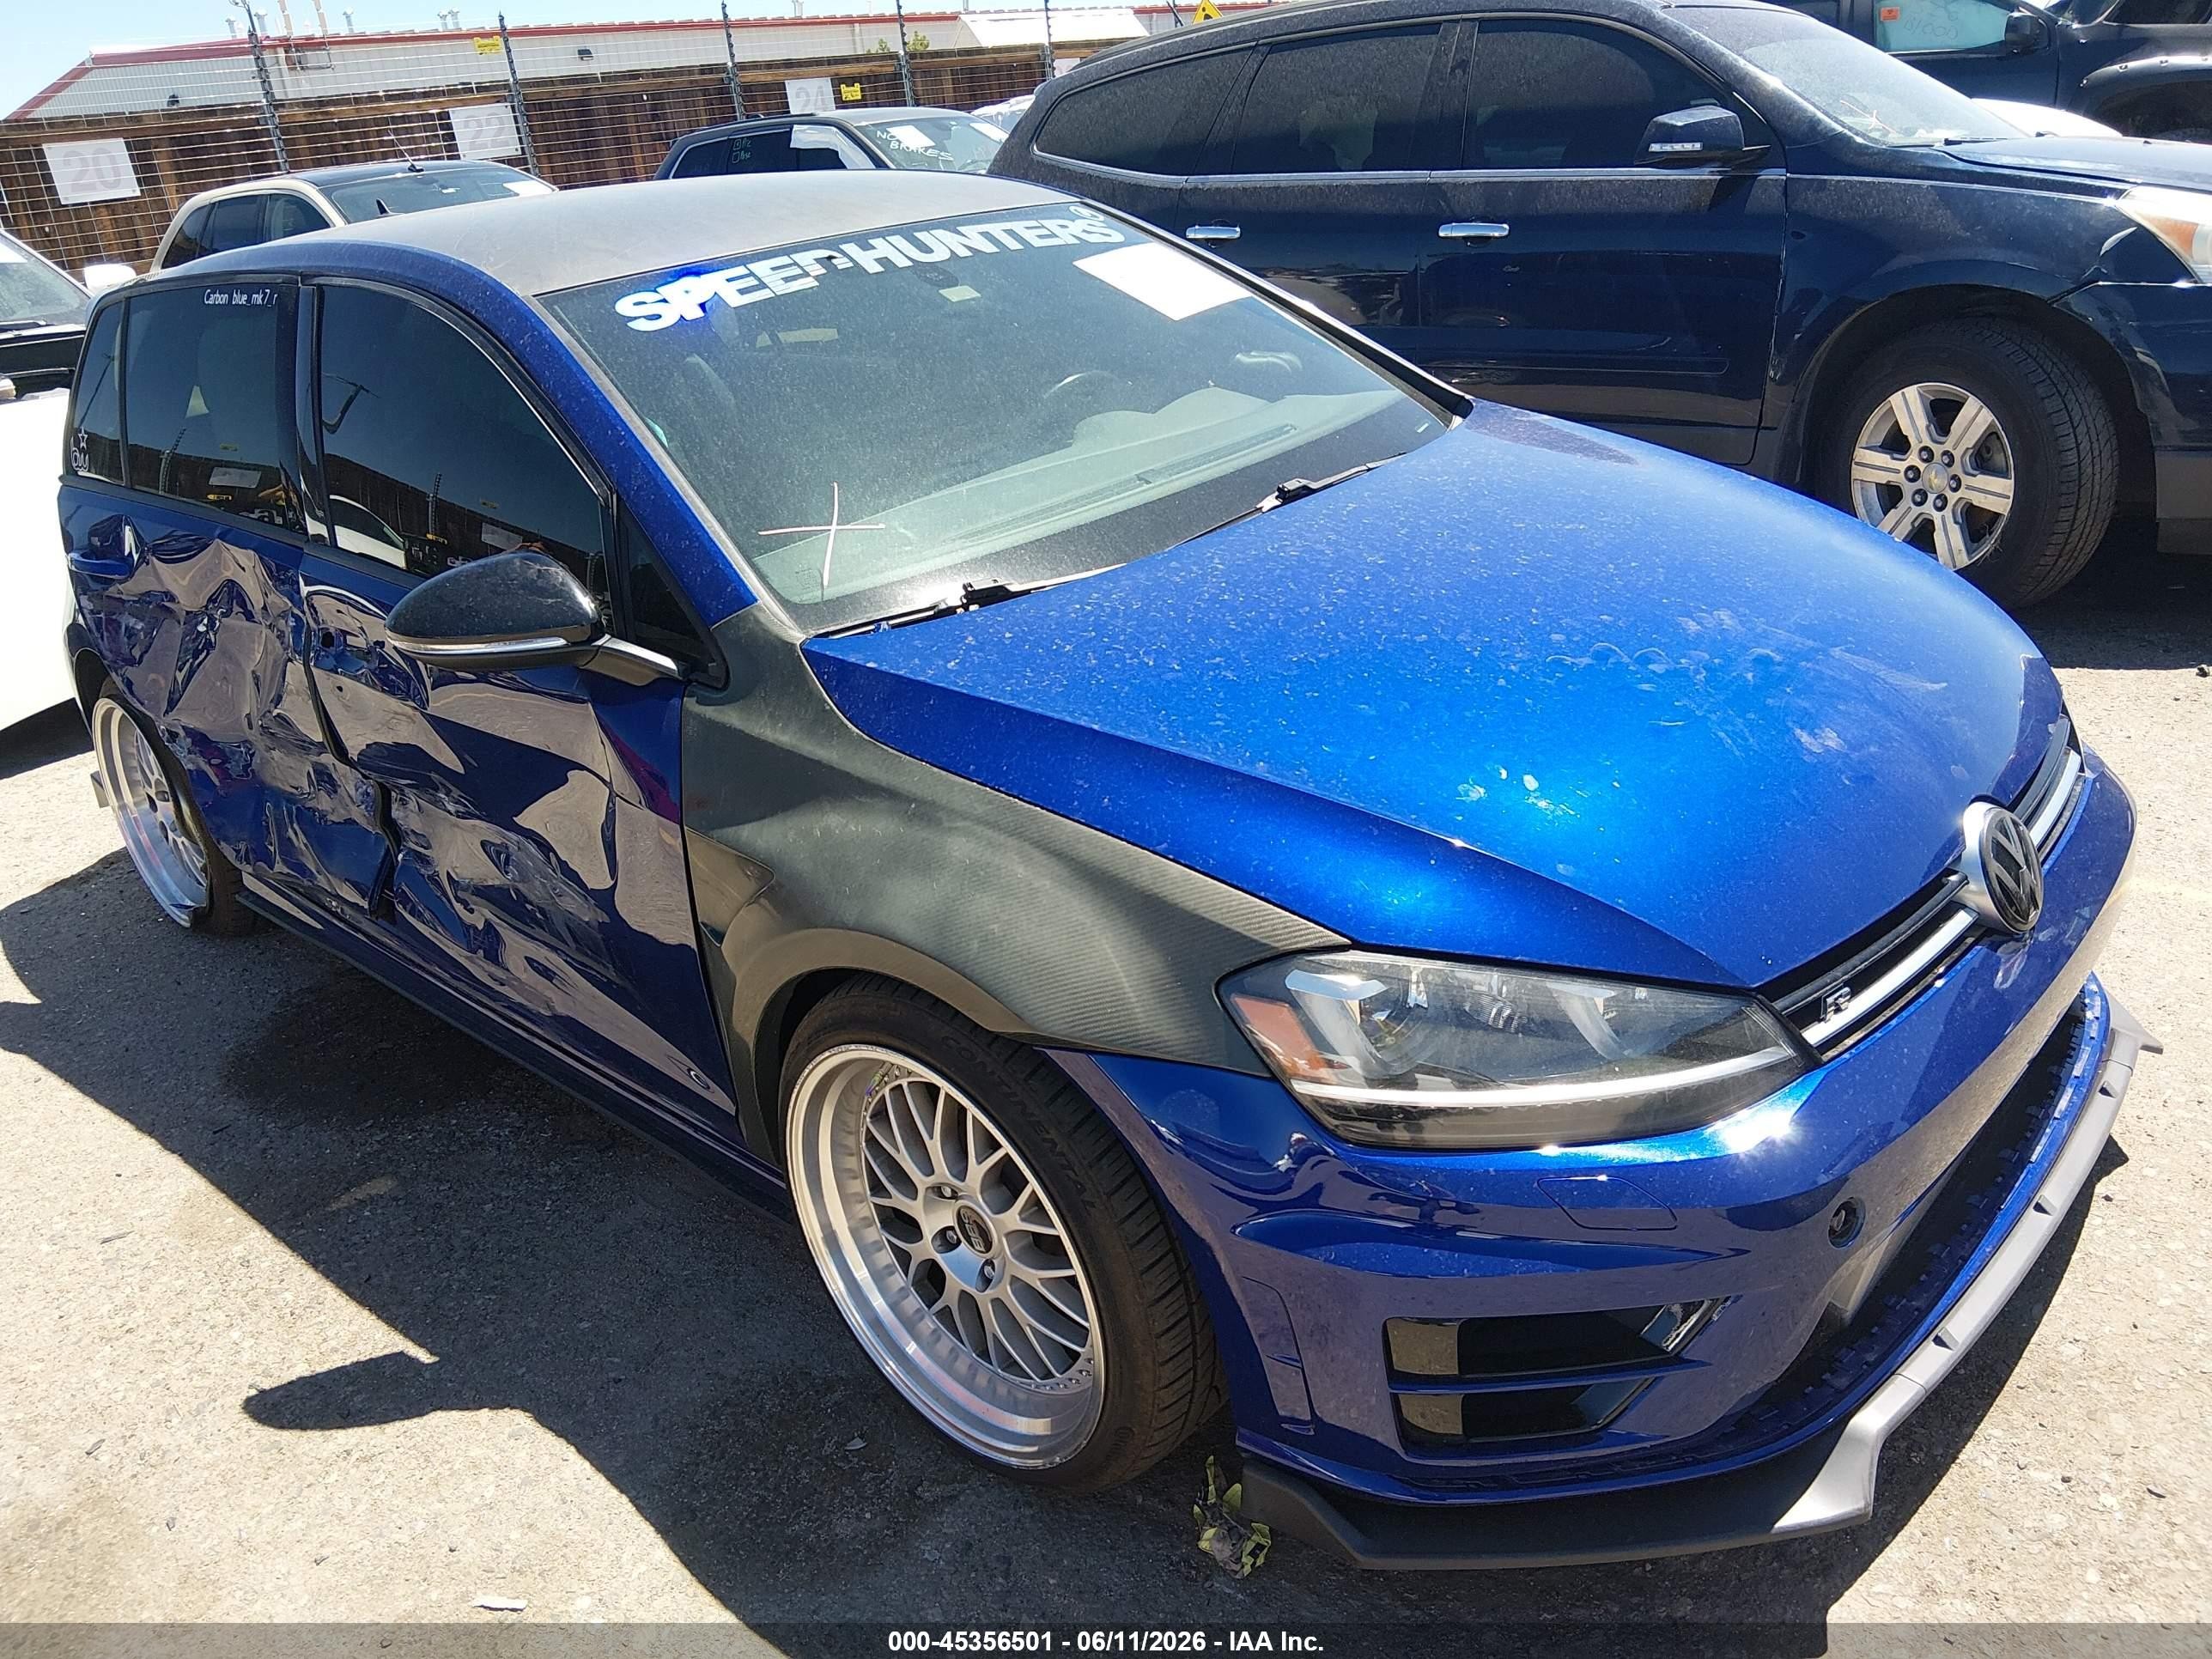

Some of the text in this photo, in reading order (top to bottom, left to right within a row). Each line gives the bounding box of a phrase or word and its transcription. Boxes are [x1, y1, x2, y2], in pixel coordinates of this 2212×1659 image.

[464, 112, 511, 151] 22
[63, 148, 121, 192] 20
[204, 289, 228, 305] Carbon
[960, 1208, 986, 1253] BBS
